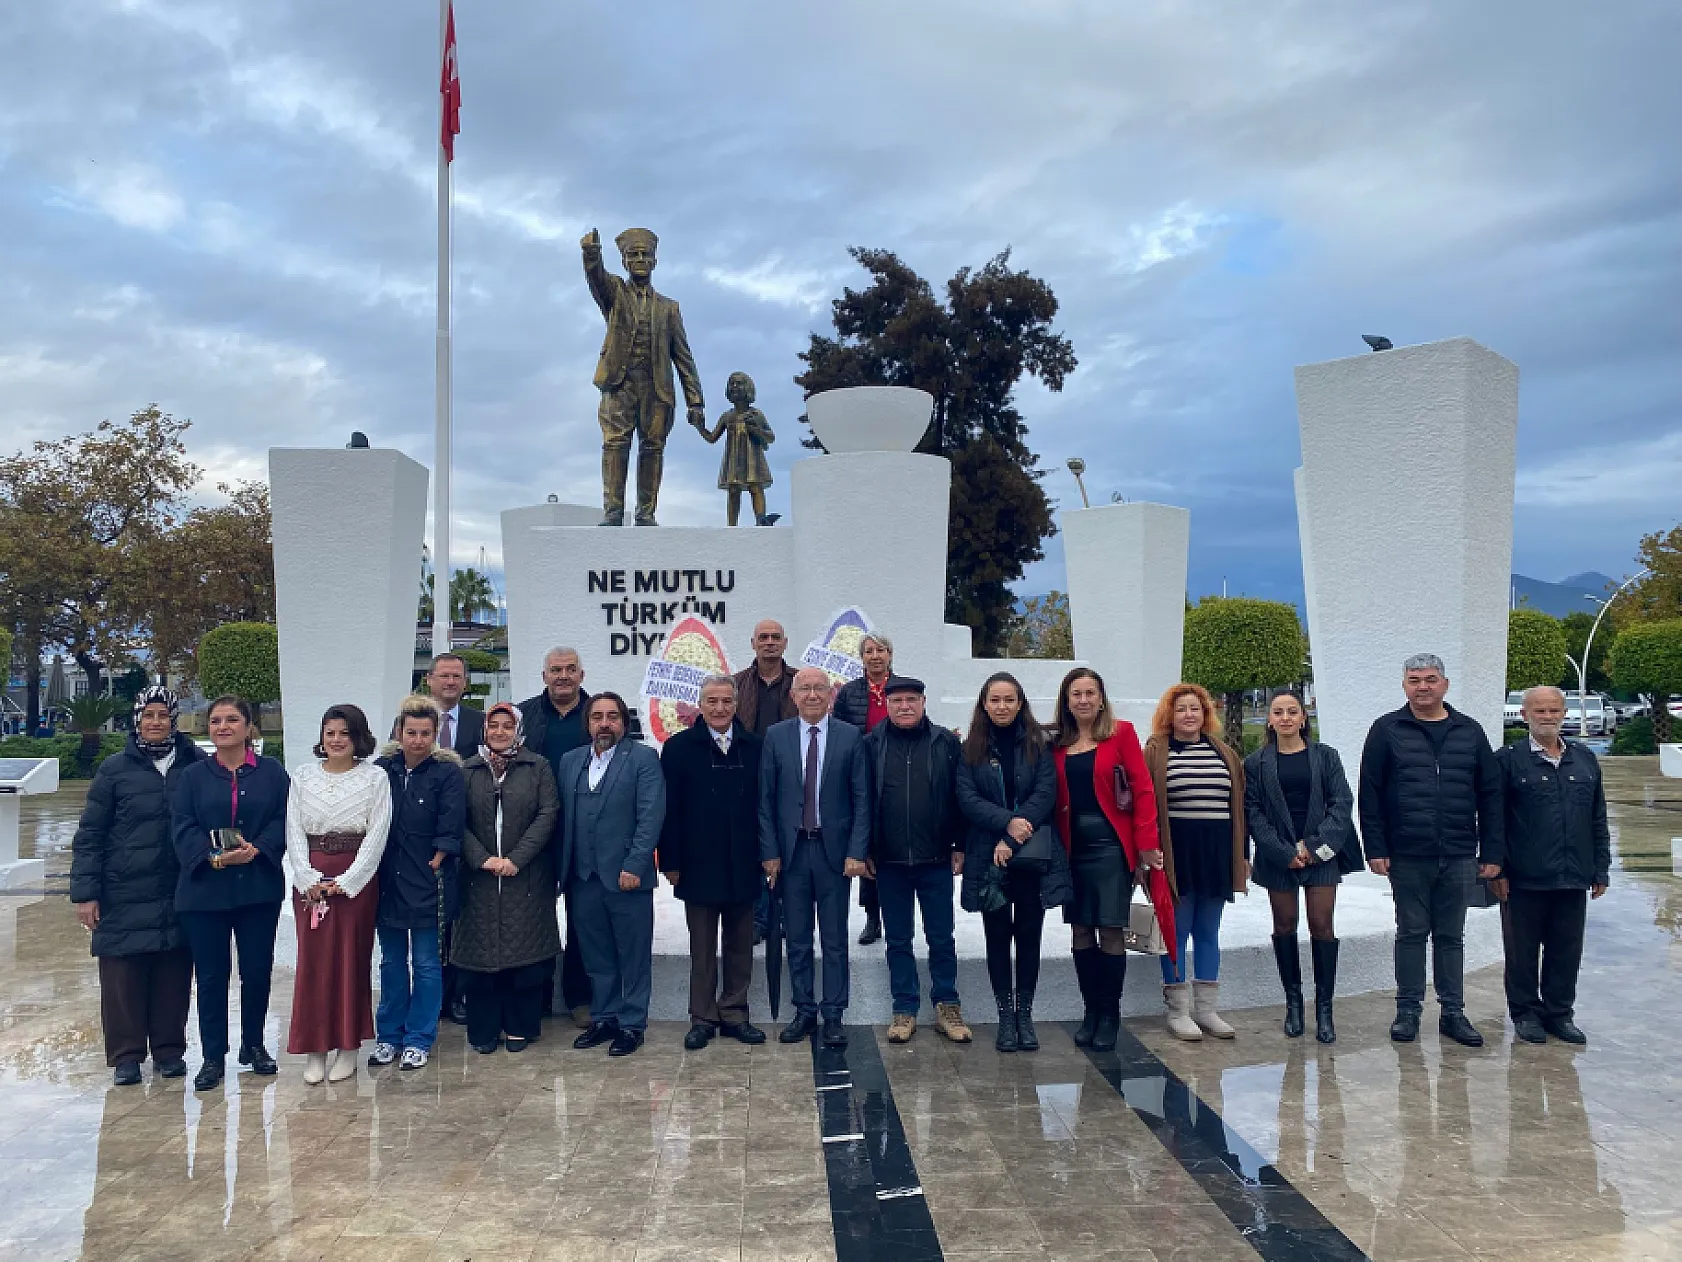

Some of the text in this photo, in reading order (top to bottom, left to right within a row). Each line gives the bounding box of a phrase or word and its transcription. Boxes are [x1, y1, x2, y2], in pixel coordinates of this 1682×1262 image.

[588, 569, 735, 593] NE MUTLU
[610, 626, 665, 656] DİY
